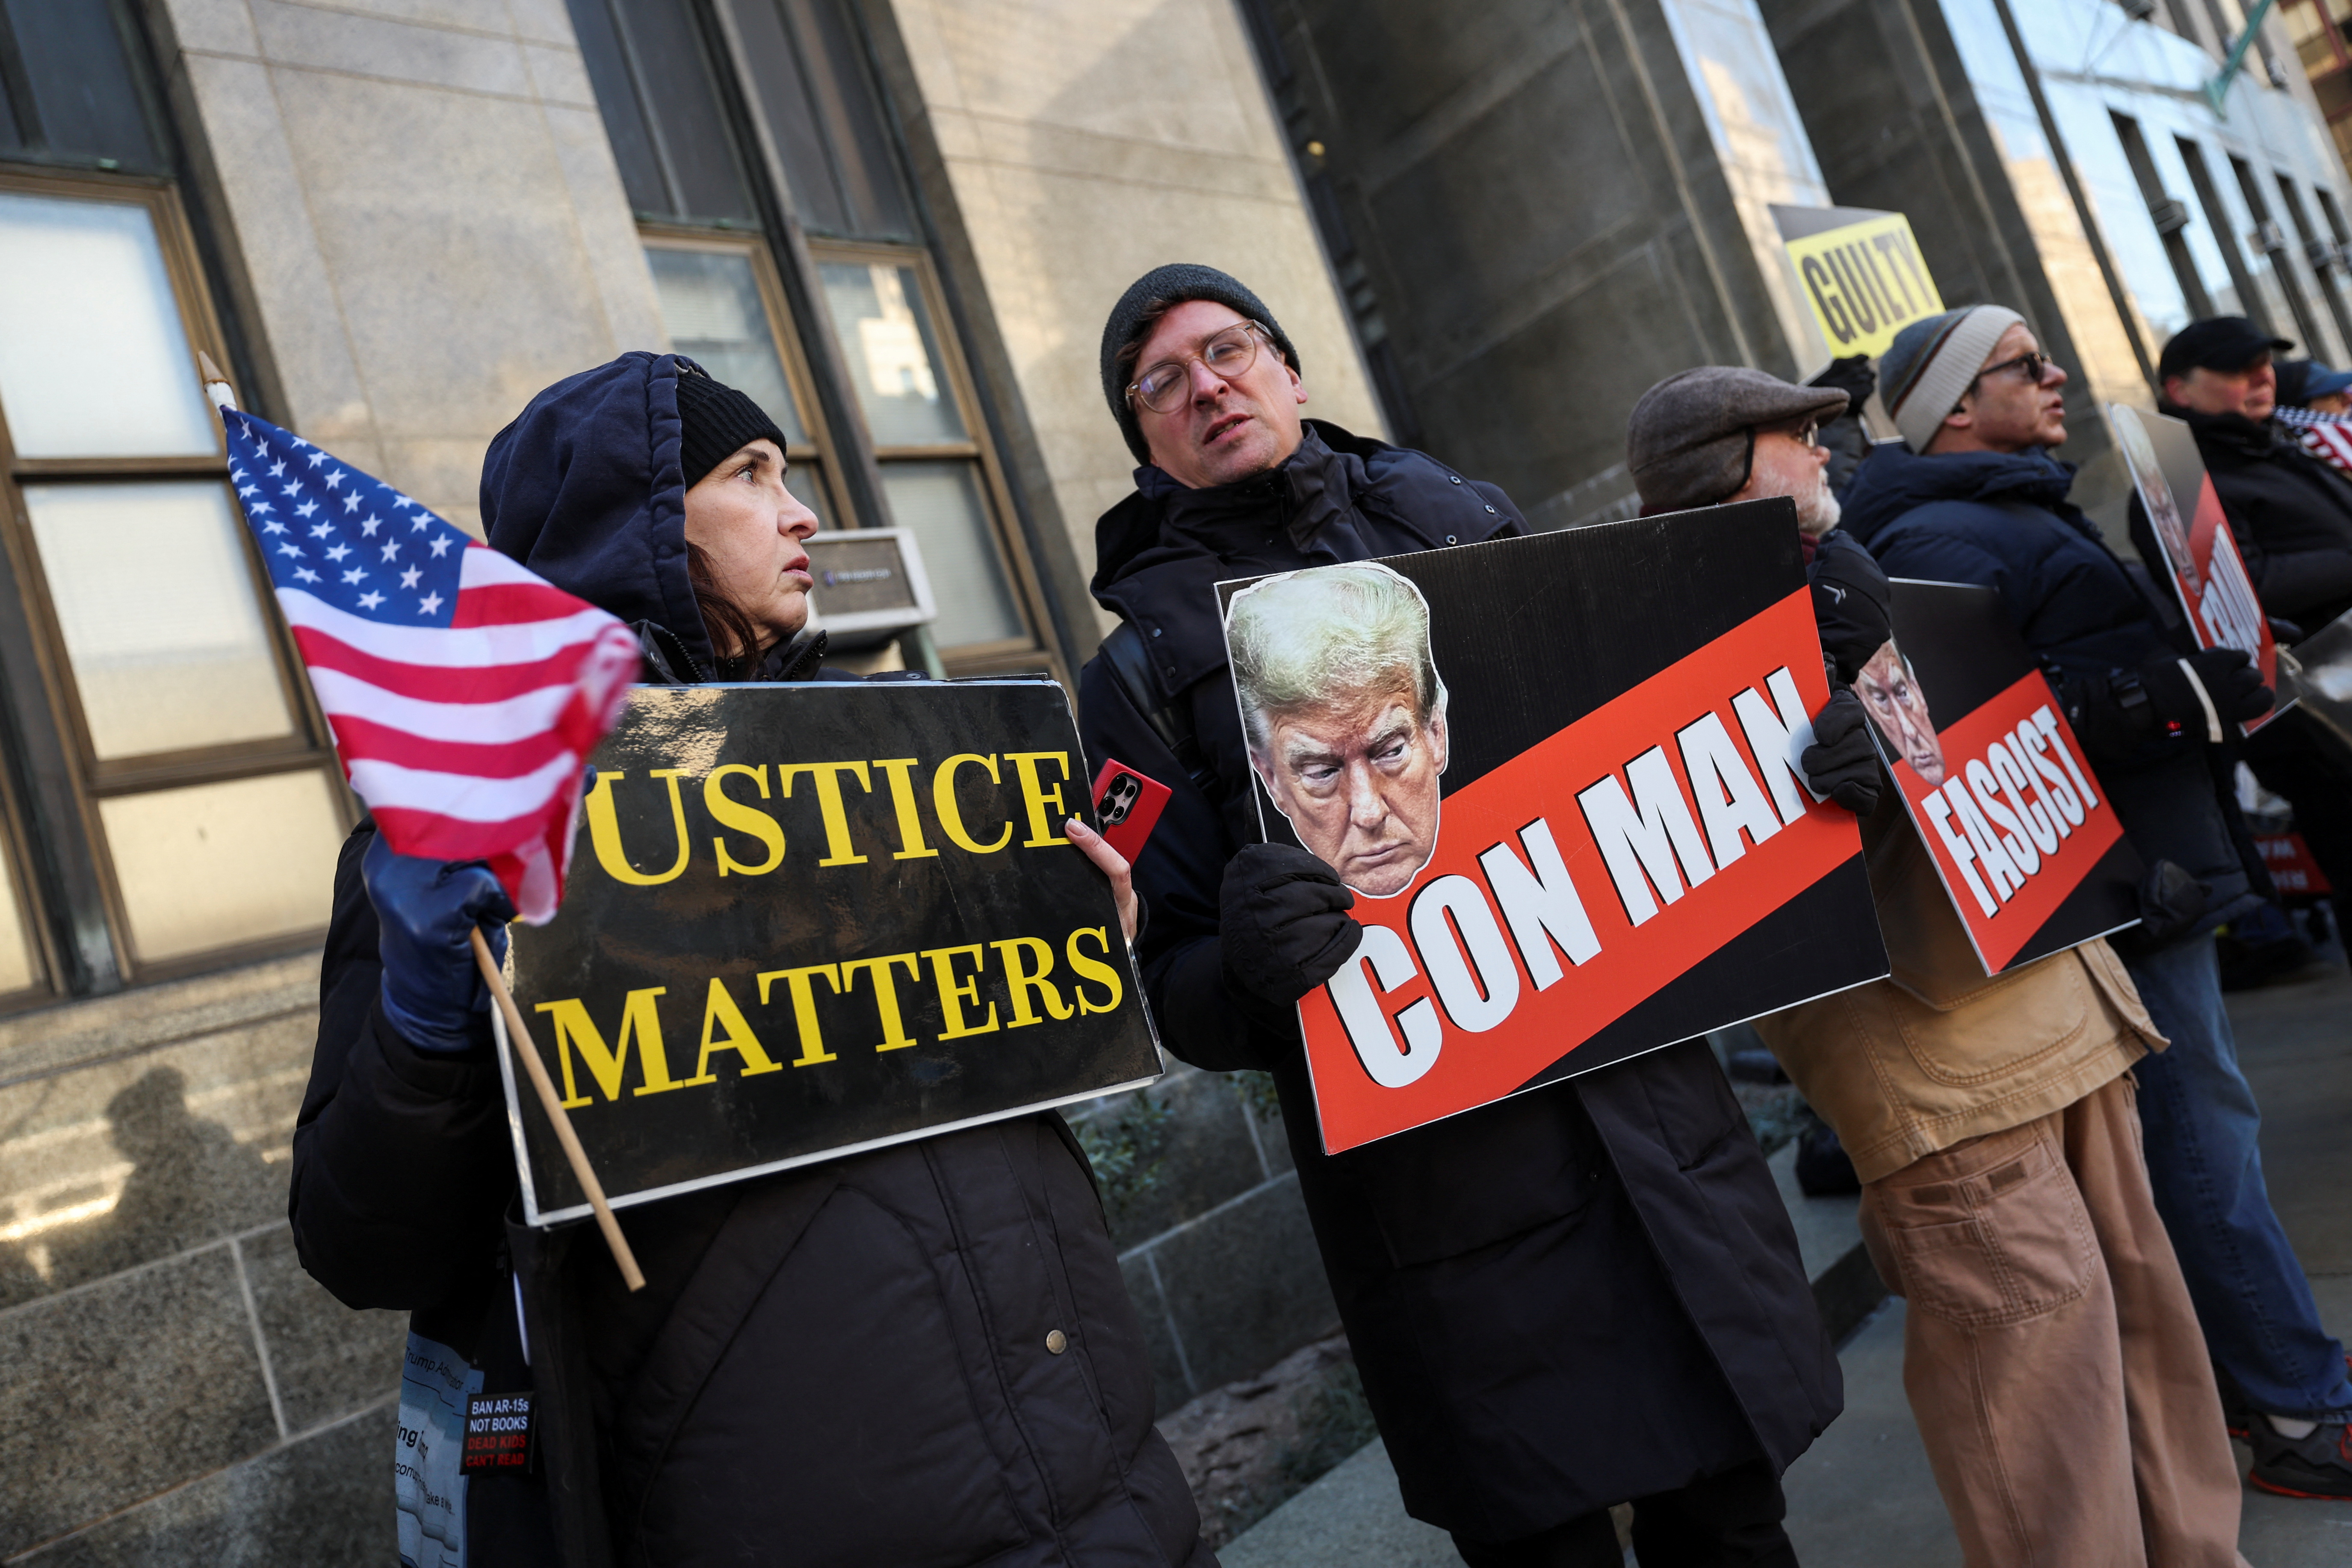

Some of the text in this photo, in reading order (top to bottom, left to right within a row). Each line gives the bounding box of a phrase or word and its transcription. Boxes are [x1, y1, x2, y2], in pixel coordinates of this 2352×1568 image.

[1802, 228, 1934, 344] GUILTY
[511, 751, 1081, 922] USTICE
[1921, 704, 2099, 919] FASCIST
[1326, 665, 1829, 1089] CON MAN
[535, 926, 1123, 1110] MATTERS
[466, 1452, 525, 1467] CAN'T READ
[467, 1434, 526, 1450] DEAD KIDS
[470, 1415, 528, 1432] NOT BOOKS
[472, 1398, 529, 1415] BAN AR-15s
